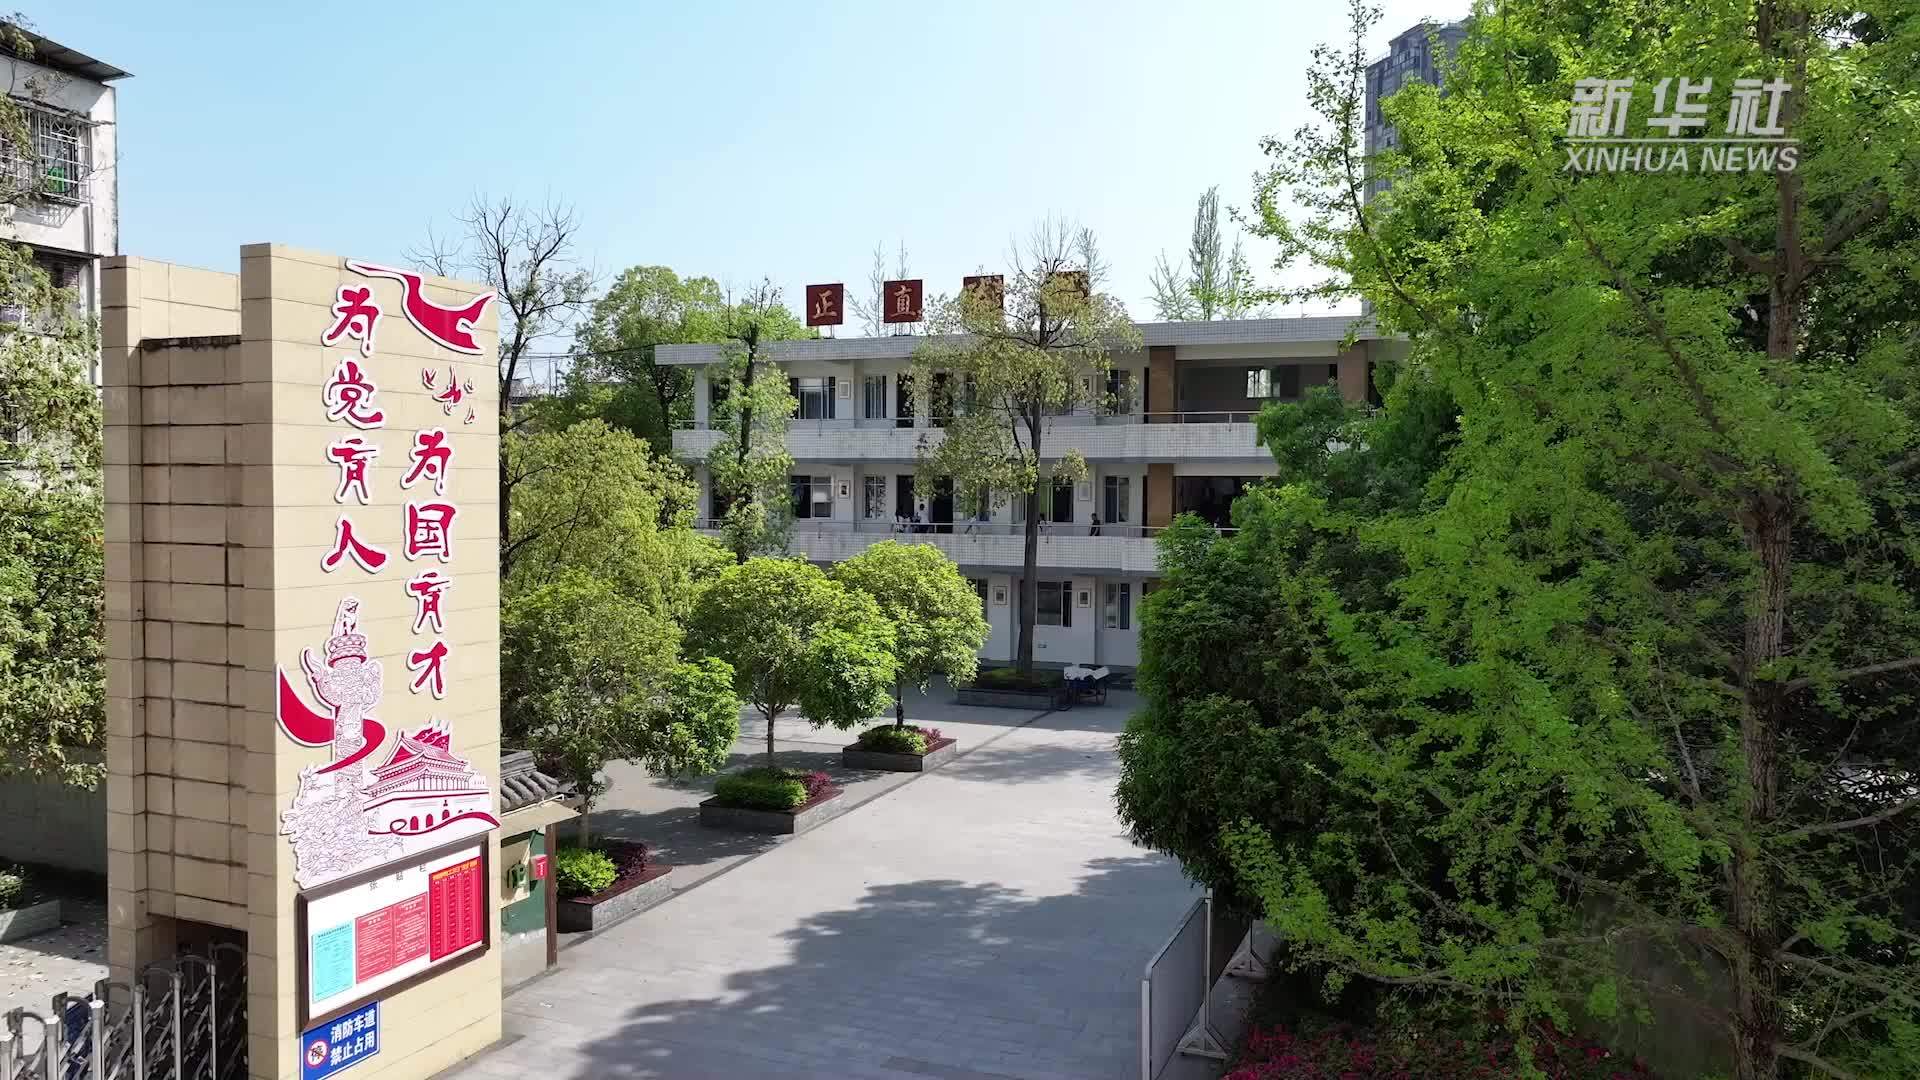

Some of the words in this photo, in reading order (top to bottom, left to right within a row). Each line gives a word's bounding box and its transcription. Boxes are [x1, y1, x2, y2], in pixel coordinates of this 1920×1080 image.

[322, 285, 387, 574] 为党育人
[402, 429, 457, 698] 为国育才
[329, 1008, 376, 1044] 消防车道
[329, 1030, 375, 1067] 禁止占用
